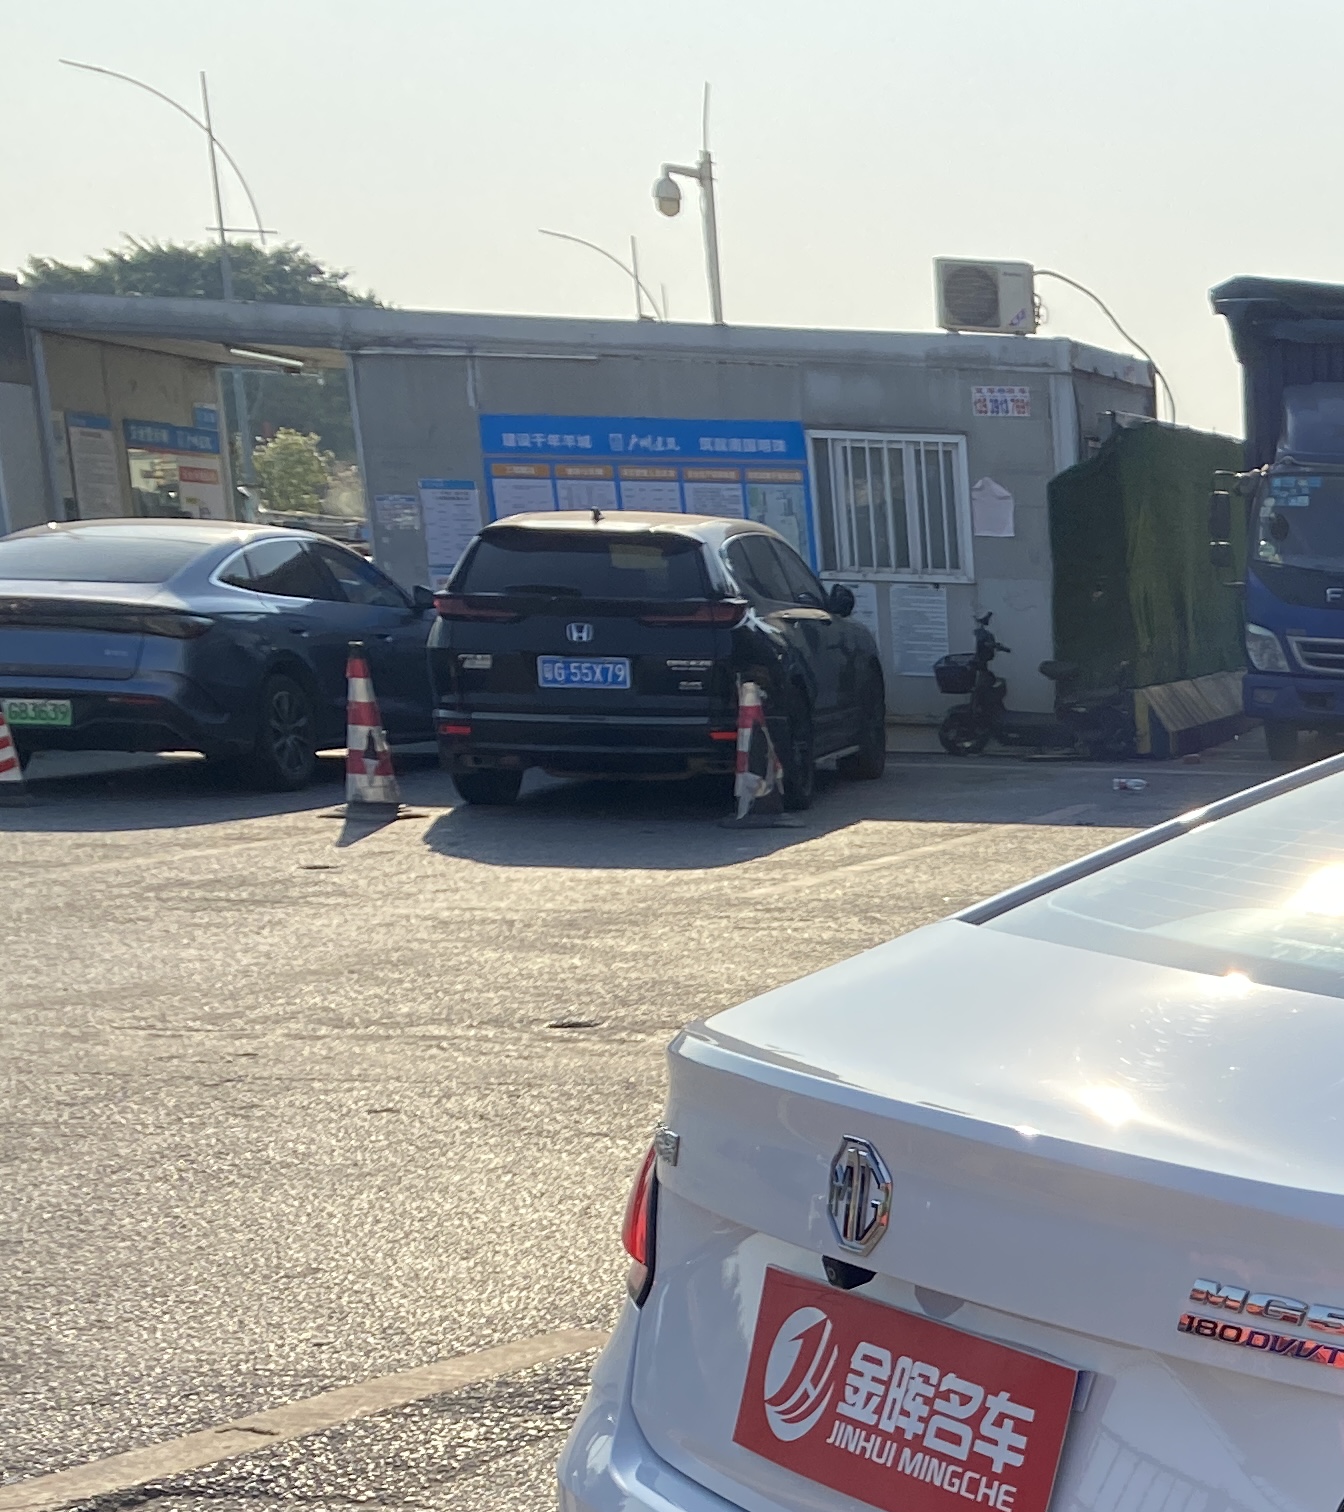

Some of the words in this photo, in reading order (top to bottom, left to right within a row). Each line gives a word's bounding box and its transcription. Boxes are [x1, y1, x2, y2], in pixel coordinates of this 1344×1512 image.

[826, 1420, 896, 1468] JINHUI
[836, 1341, 1036, 1474] 金晖名车
